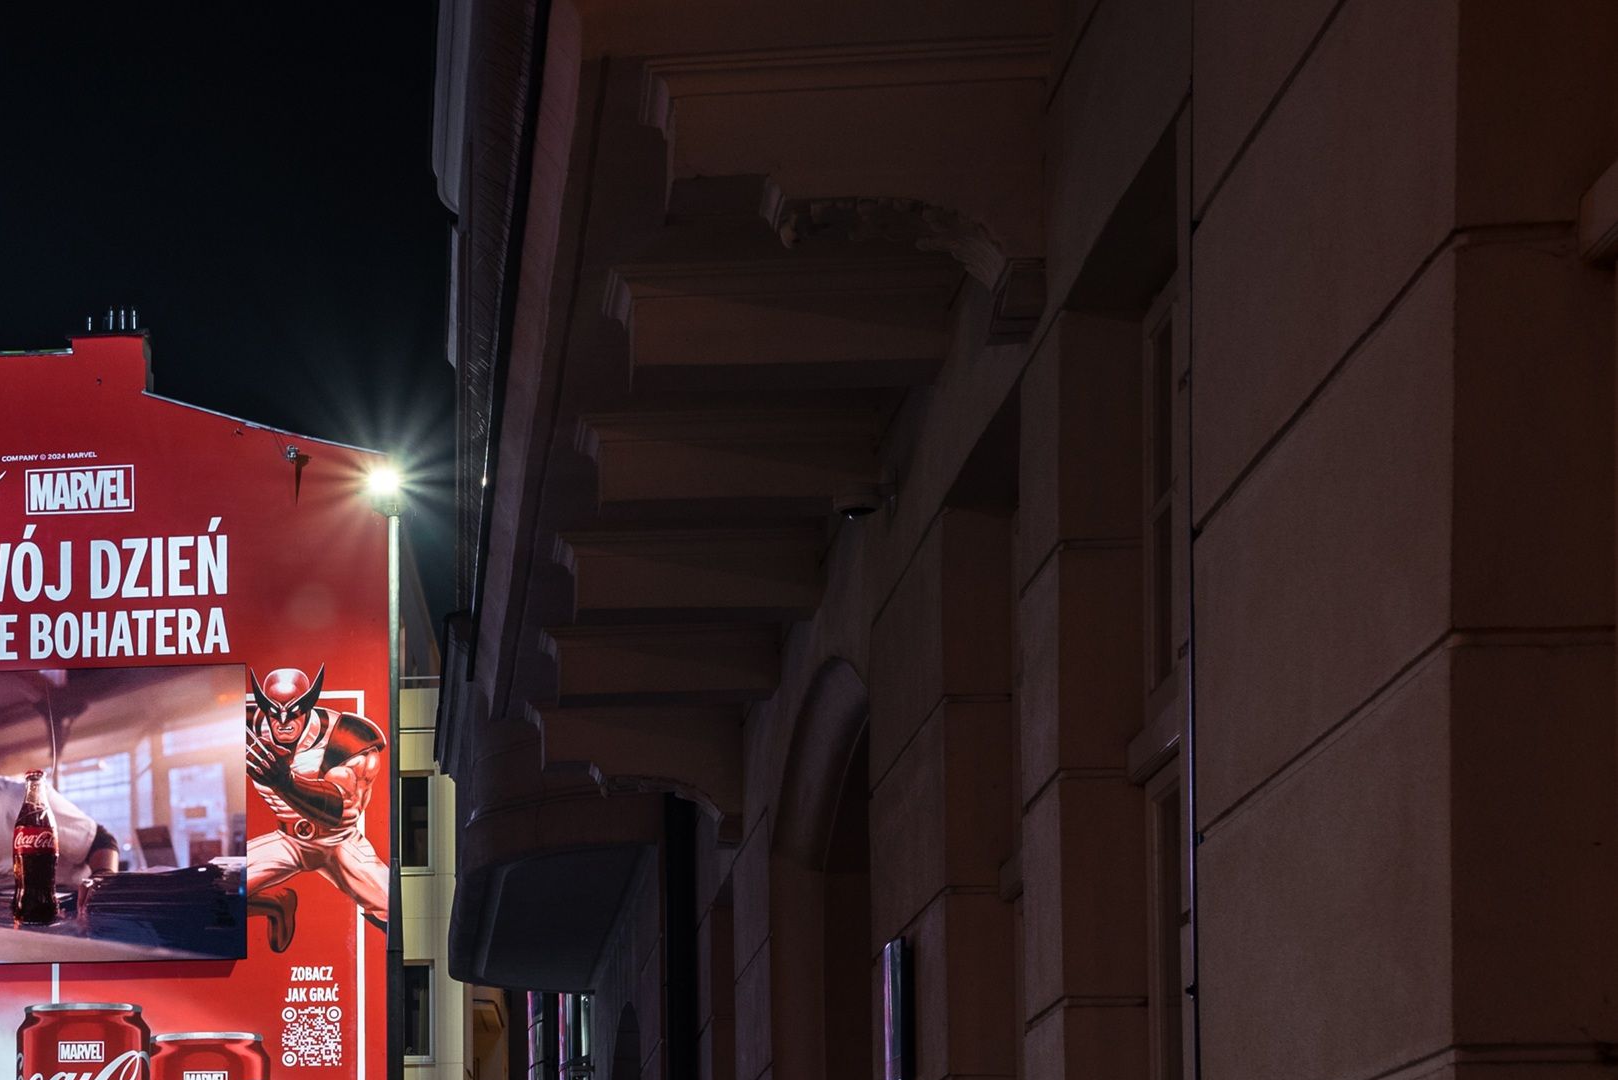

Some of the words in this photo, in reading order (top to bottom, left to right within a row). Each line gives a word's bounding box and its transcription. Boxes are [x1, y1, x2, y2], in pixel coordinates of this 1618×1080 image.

[1, 454, 39, 463] COMPANY
[48, 452, 66, 461] 2024
[67, 451, 97, 460] MARVEL
[29, 470, 130, 511] MARVEL
[90, 516, 228, 599] DZIEŃ
[30, 607, 230, 660] BOHATERA
[290, 966, 333, 981] ZOBACZ
[285, 988, 307, 1002] JAK
[309, 983, 339, 1002] GRAĆ
[60, 1043, 102, 1061] MARVEL
